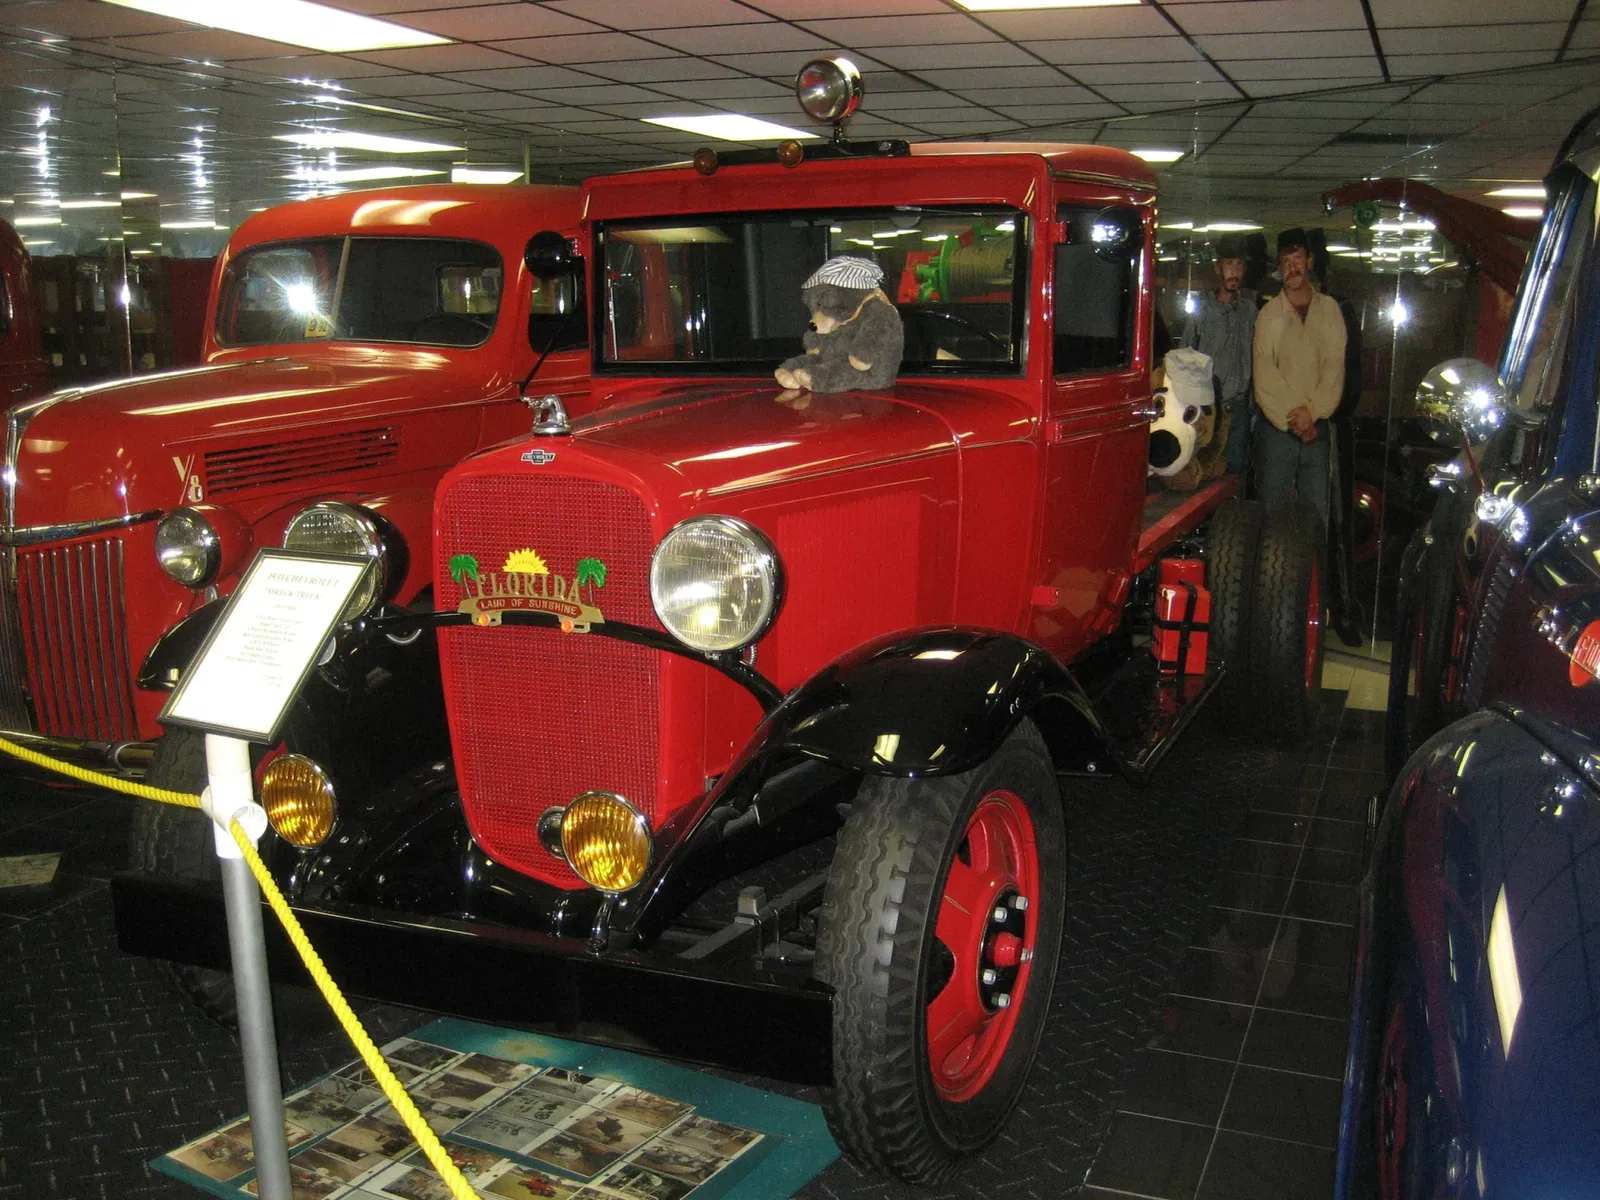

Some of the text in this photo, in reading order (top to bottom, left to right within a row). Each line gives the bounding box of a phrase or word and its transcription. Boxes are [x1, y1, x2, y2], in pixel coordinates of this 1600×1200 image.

[476, 573, 582, 605] FLORIDA
[481, 598, 577, 615] LAND OF SUNSHINE
